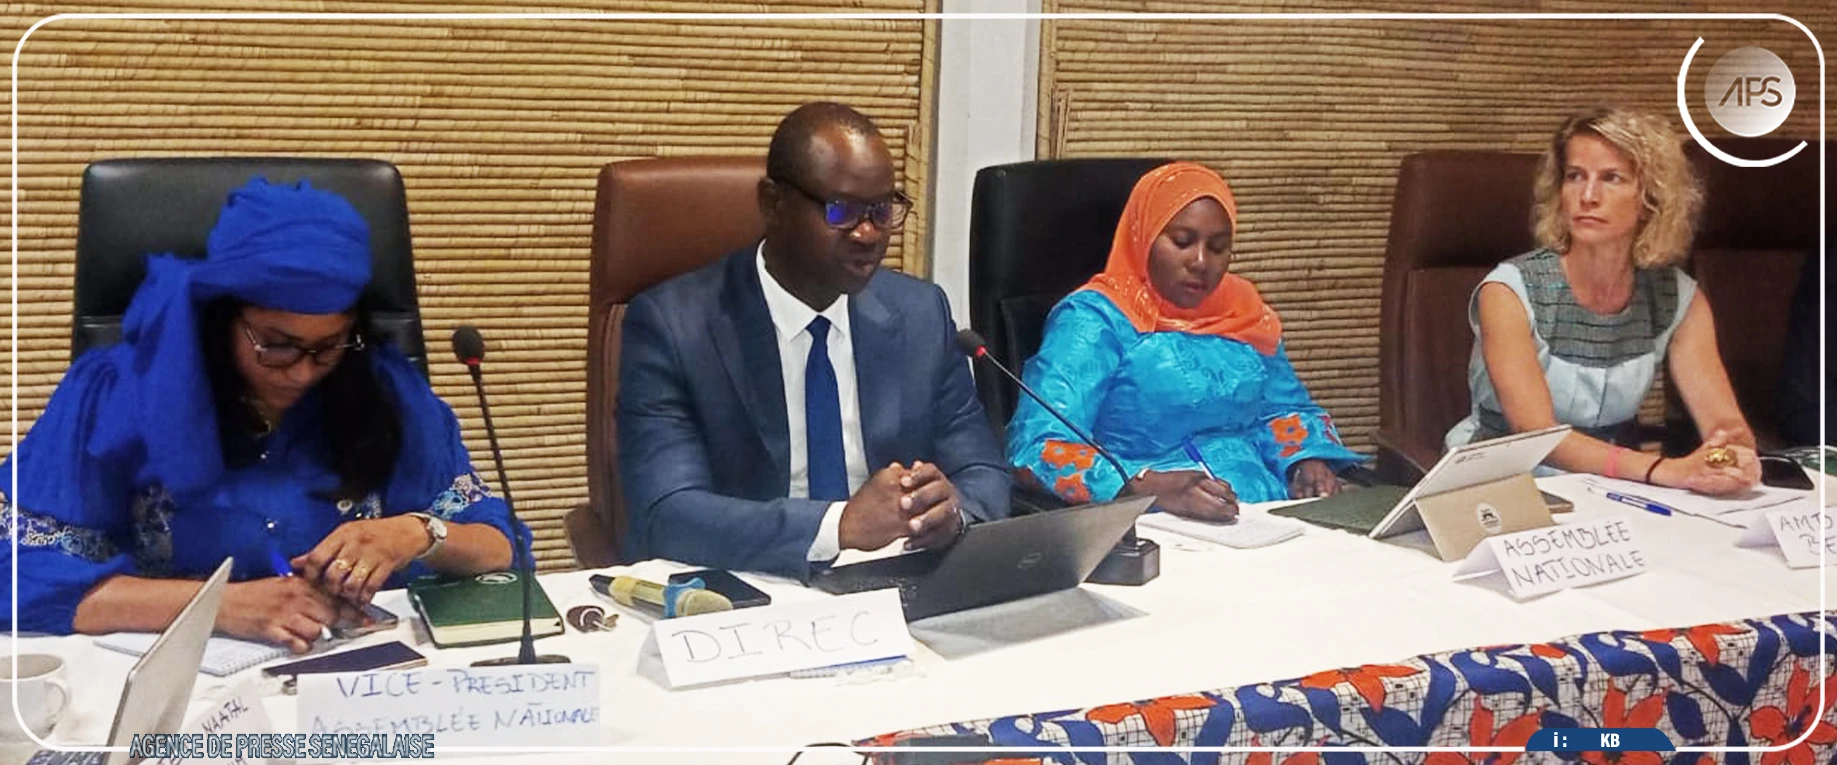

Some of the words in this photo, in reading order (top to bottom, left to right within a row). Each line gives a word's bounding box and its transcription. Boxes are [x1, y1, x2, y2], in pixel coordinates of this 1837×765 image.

[1511, 550, 1645, 588] NATIONALE
[672, 610, 880, 663] DIREC
[337, 672, 421, 697] VICE
